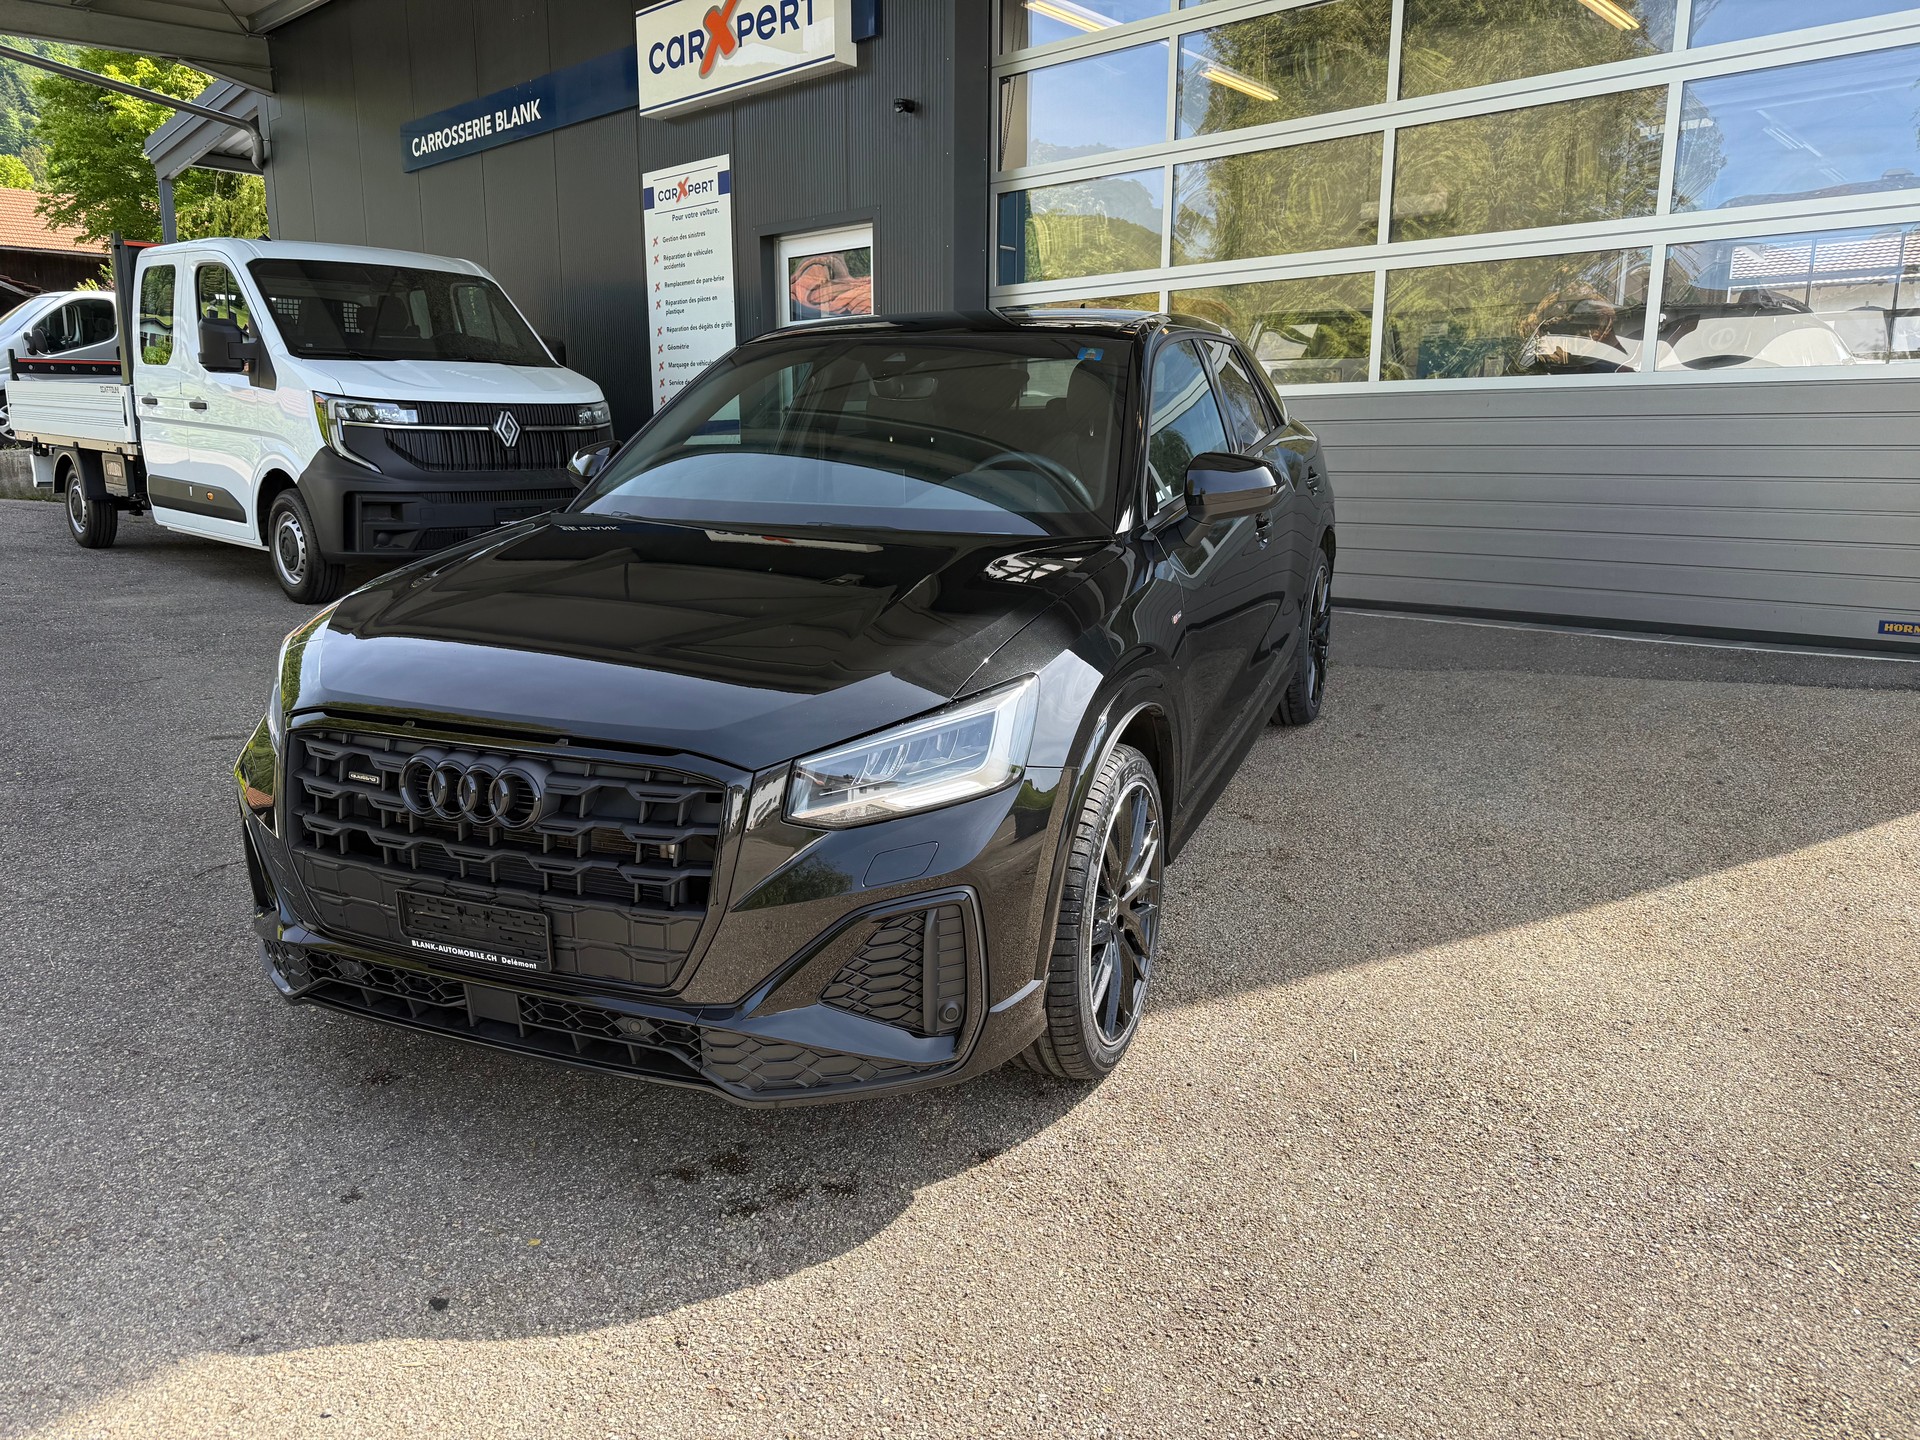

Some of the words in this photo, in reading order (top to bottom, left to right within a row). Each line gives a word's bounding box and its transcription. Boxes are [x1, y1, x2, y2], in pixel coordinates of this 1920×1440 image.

[412, 114, 493, 157] CARROSSERIE
[495, 98, 541, 133] BLANK
[672, 213, 684, 221] Pour
[685, 211, 699, 219] votre
[700, 207, 720, 217] voiture.
[662, 235, 679, 244] Gestion
[688, 231, 706, 239] sinistres
[663, 252, 686, 262] Réparation
[693, 248, 713, 257] véhicules
[663, 262, 686, 270] accidentés
[664, 279, 695, 288] Remplacement
[702, 275, 725, 284] pare-brise
[665, 297, 688, 307] Réparation
[689, 296, 697, 304] des
[697, 295, 711, 304] pièces
[665, 308, 685, 316] plastique
[666, 325, 689, 334] Réparation
[698, 323, 713, 332] dégâts
[721, 321, 733, 330] grêle
[667, 343, 690, 351] Géométrie
[668, 360, 689, 369] Marquage
[690, 359, 696, 367] de
[411, 940, 498, 962] BLANK-AUTOMOBILE.CH
[501, 956, 537, 969] Delémont
